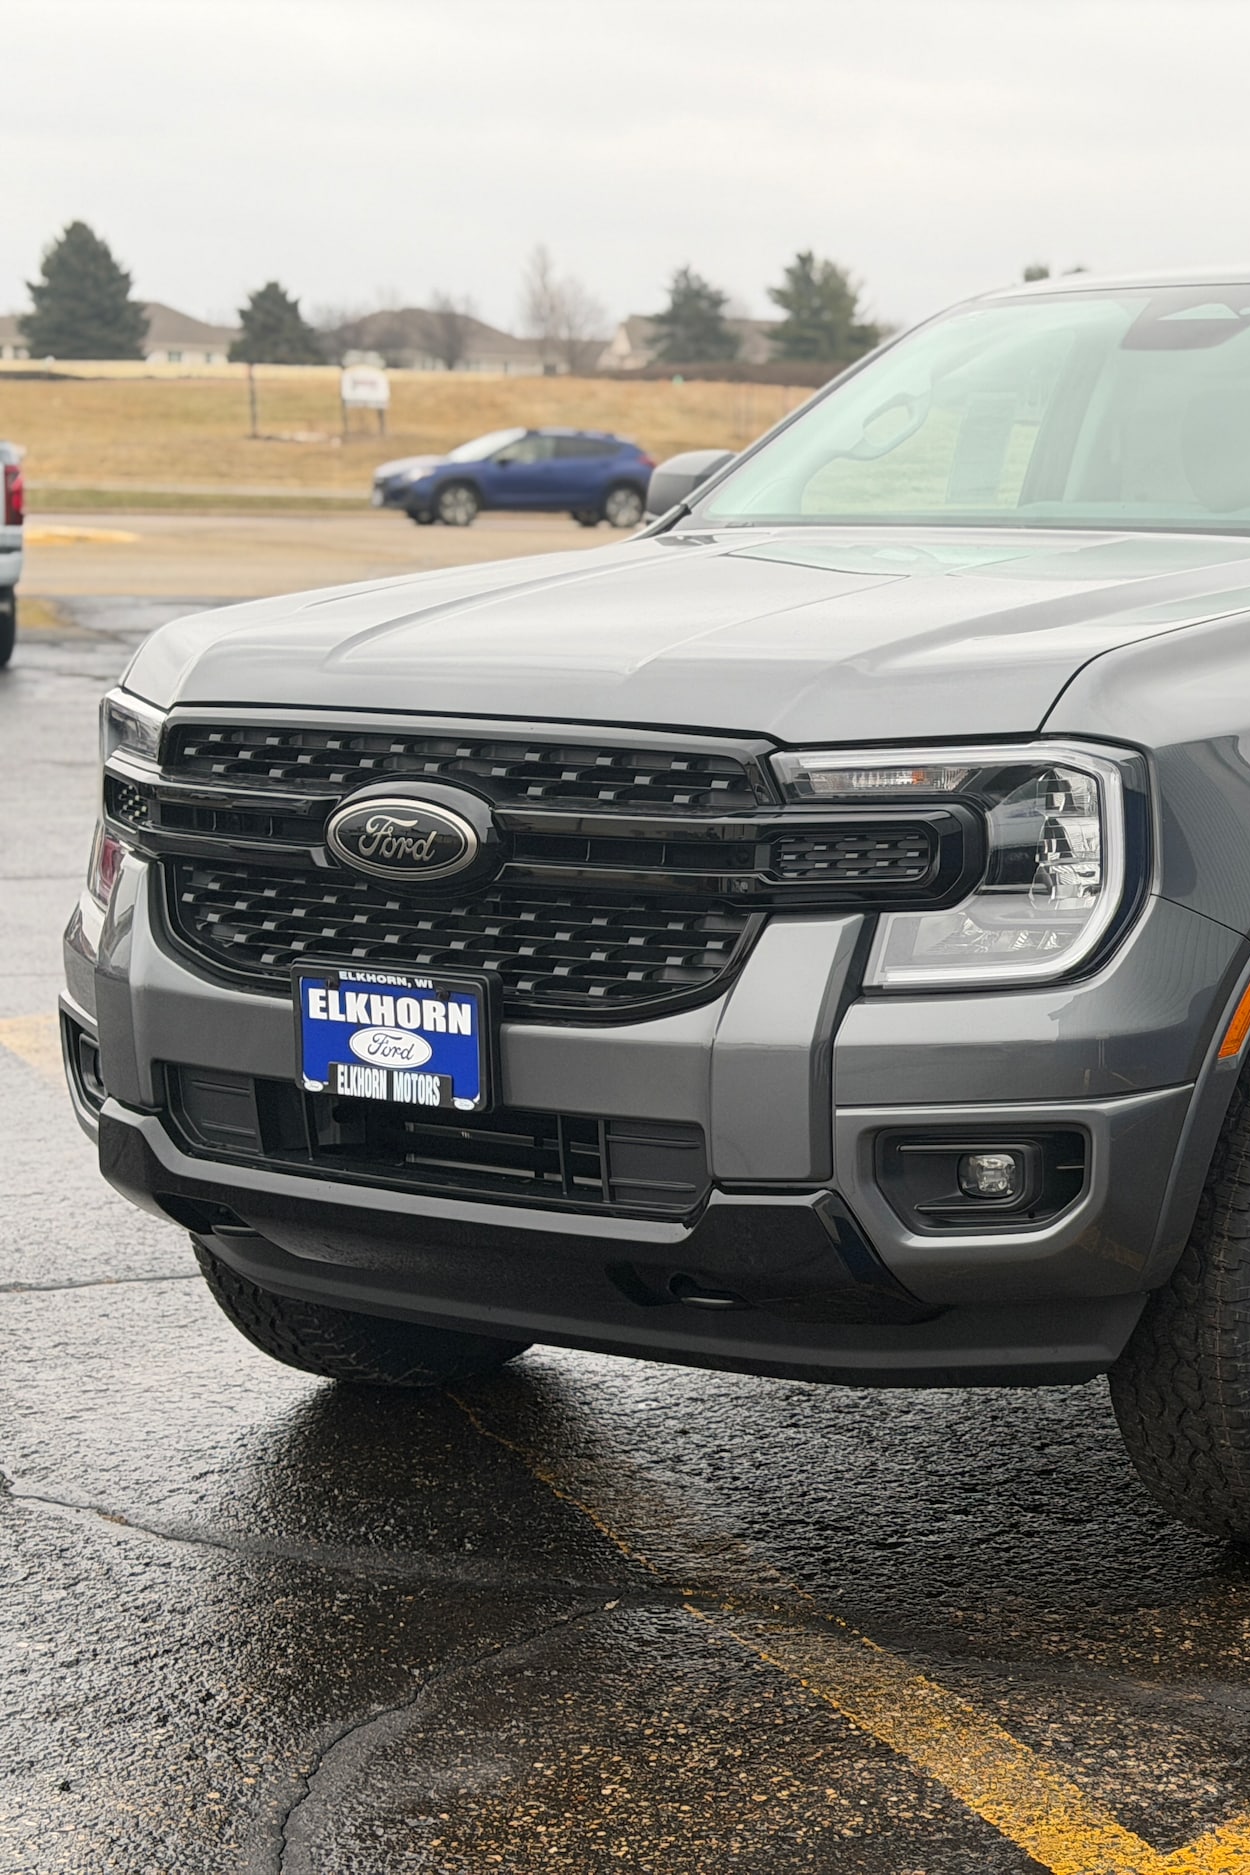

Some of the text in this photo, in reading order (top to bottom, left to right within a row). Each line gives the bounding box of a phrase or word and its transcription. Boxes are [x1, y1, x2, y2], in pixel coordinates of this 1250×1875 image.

[358, 814, 438, 862] Ford
[338, 970, 433, 989] ELKHORN, WI
[308, 988, 472, 1036] ELKHORN
[367, 1032, 415, 1061] Ford
[337, 1064, 440, 1107] ELKHORN MOTORS
